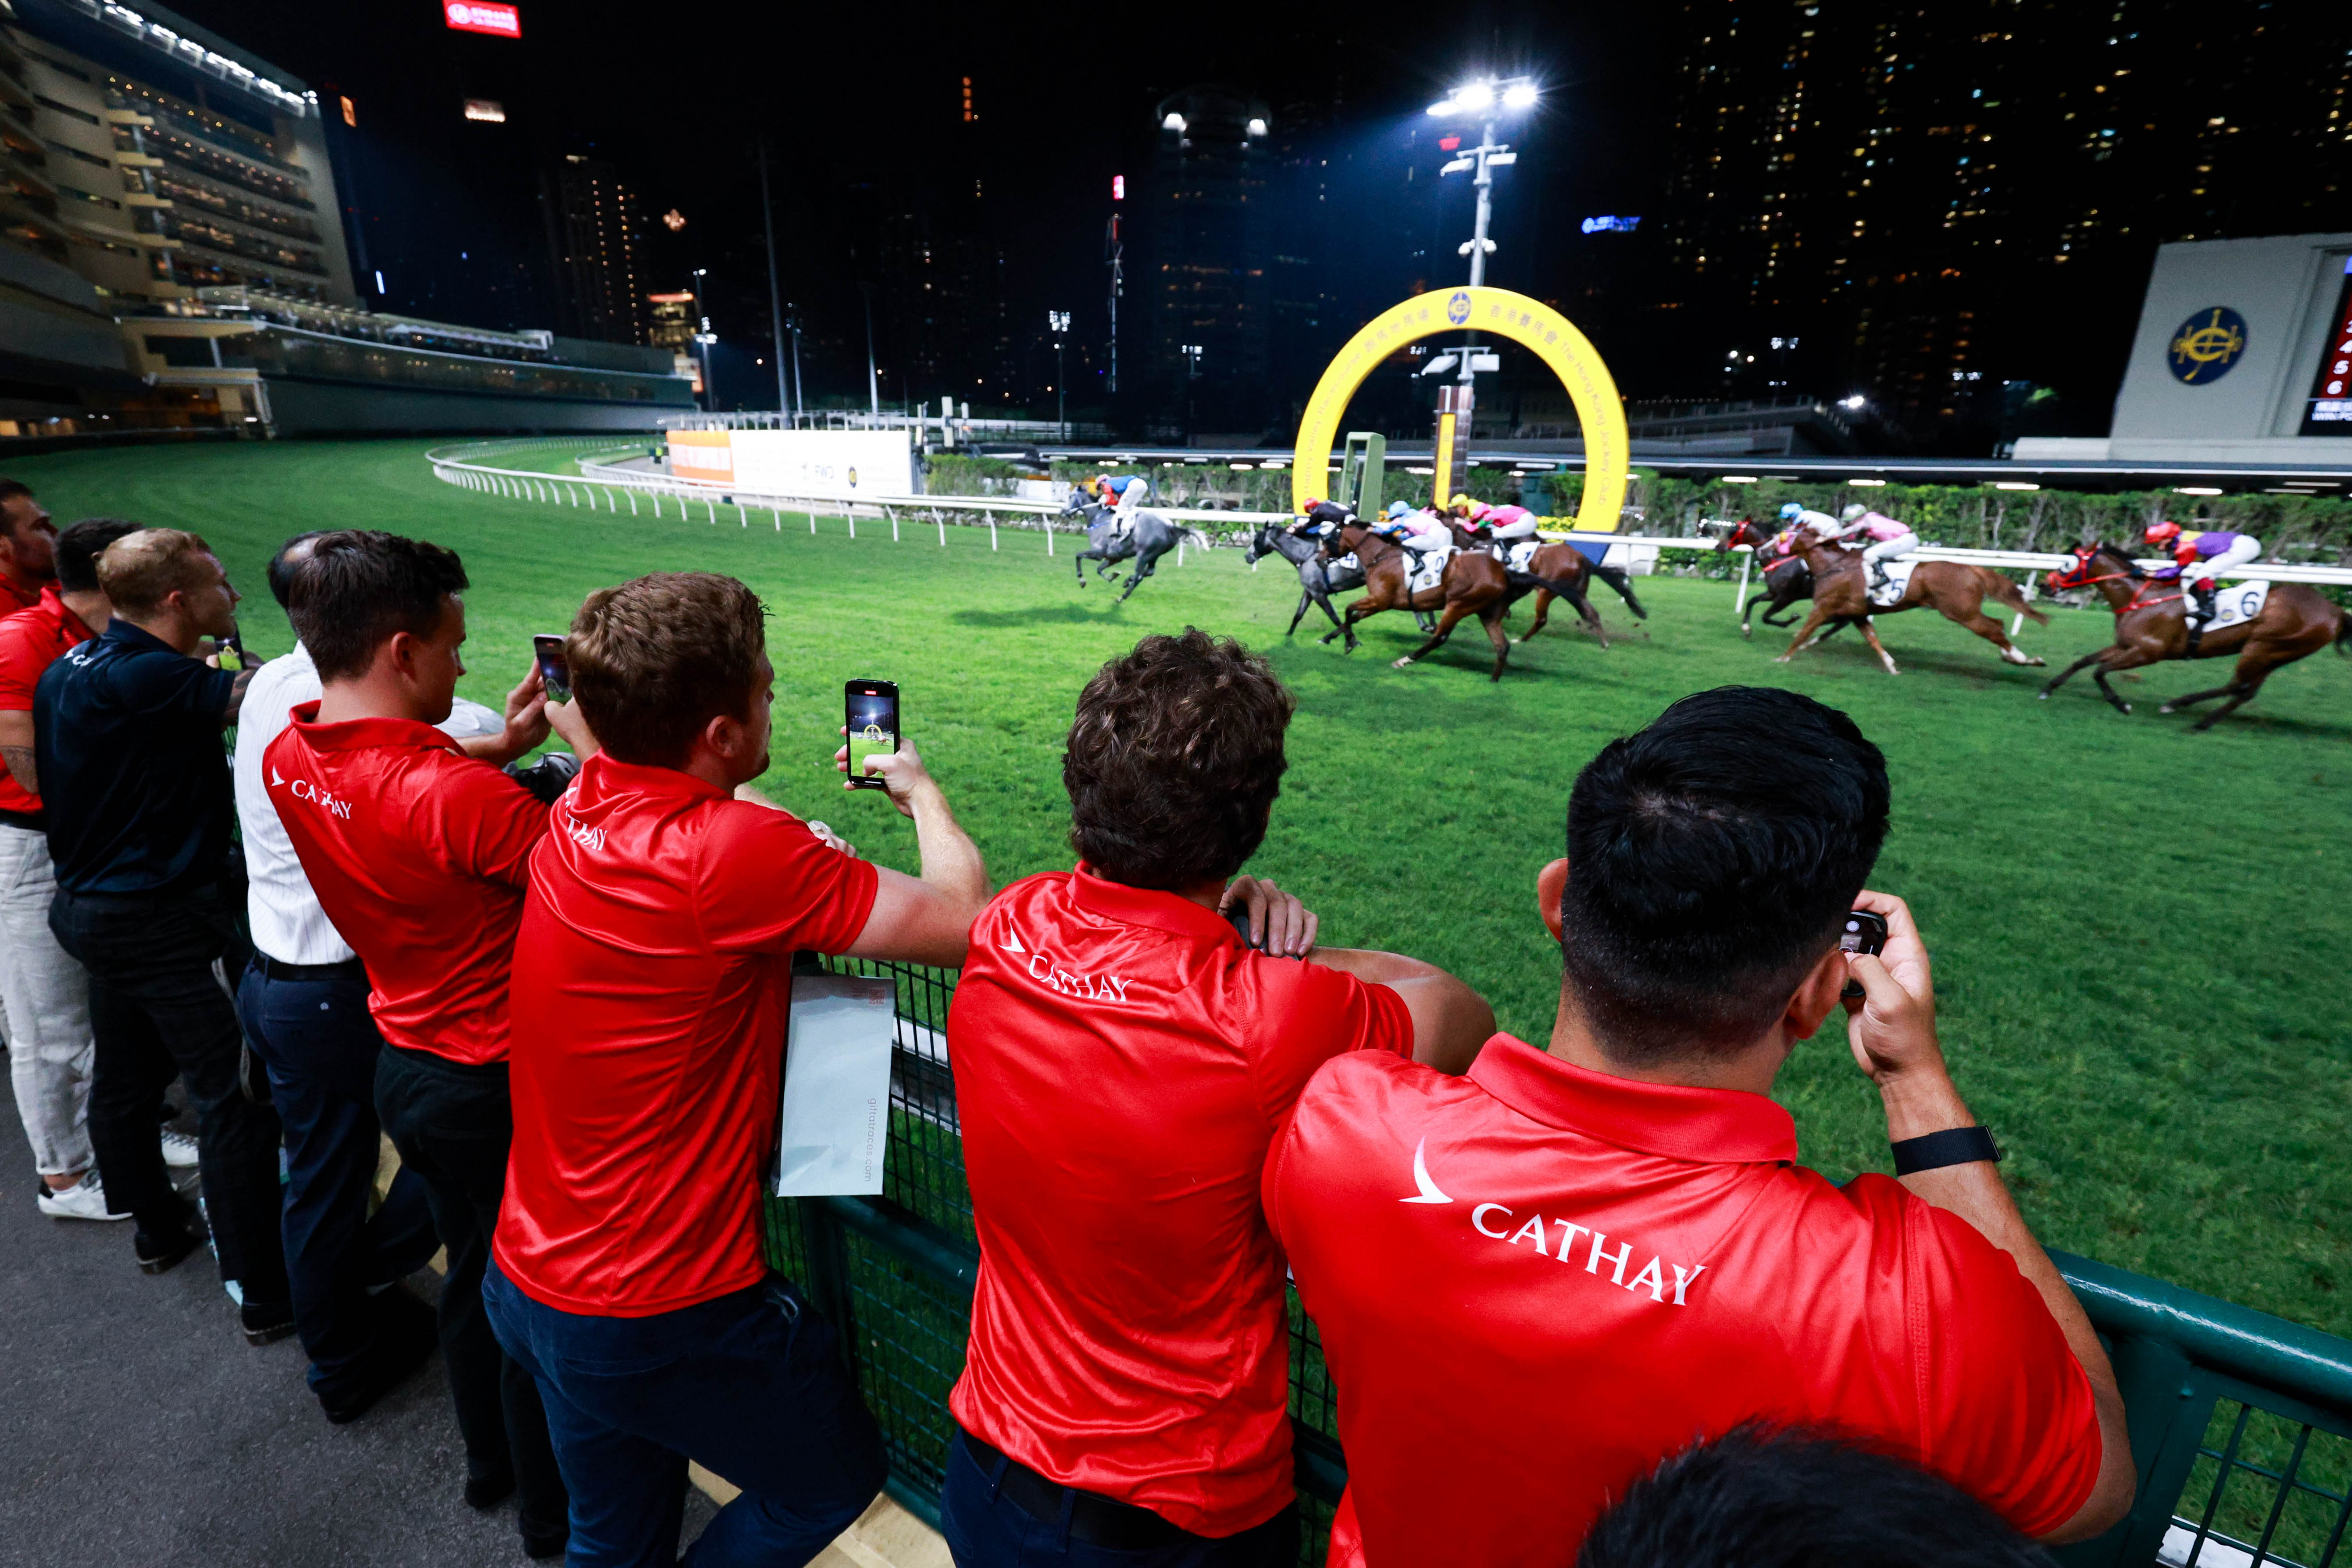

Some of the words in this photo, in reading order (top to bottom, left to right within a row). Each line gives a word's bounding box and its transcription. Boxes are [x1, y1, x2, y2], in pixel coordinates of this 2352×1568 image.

[1490, 305, 1558, 345] 香港賽馬會
[1560, 341, 1575, 363] The
[2333, 360, 2349, 374] 5
[1318, 352, 1362, 415] Racecourse
[1574, 361, 1594, 394] Hong
[2327, 380, 2343, 394] 6
[1591, 392, 1606, 426] Kong
[1308, 421, 1323, 452] Valley
[1600, 429, 1611, 473] Jockey
[1304, 457, 1313, 494] Happy
[1597, 475, 1612, 506] Club
[1346, 553, 1354, 565] 4
[1888, 579, 1906, 604] 5
[2241, 591, 2260, 617] 6
[1028, 954, 1135, 1002] CATHAY
[864, 1098, 878, 1182] giftatraces.com
[1471, 1203, 1708, 1306] CATHAY
